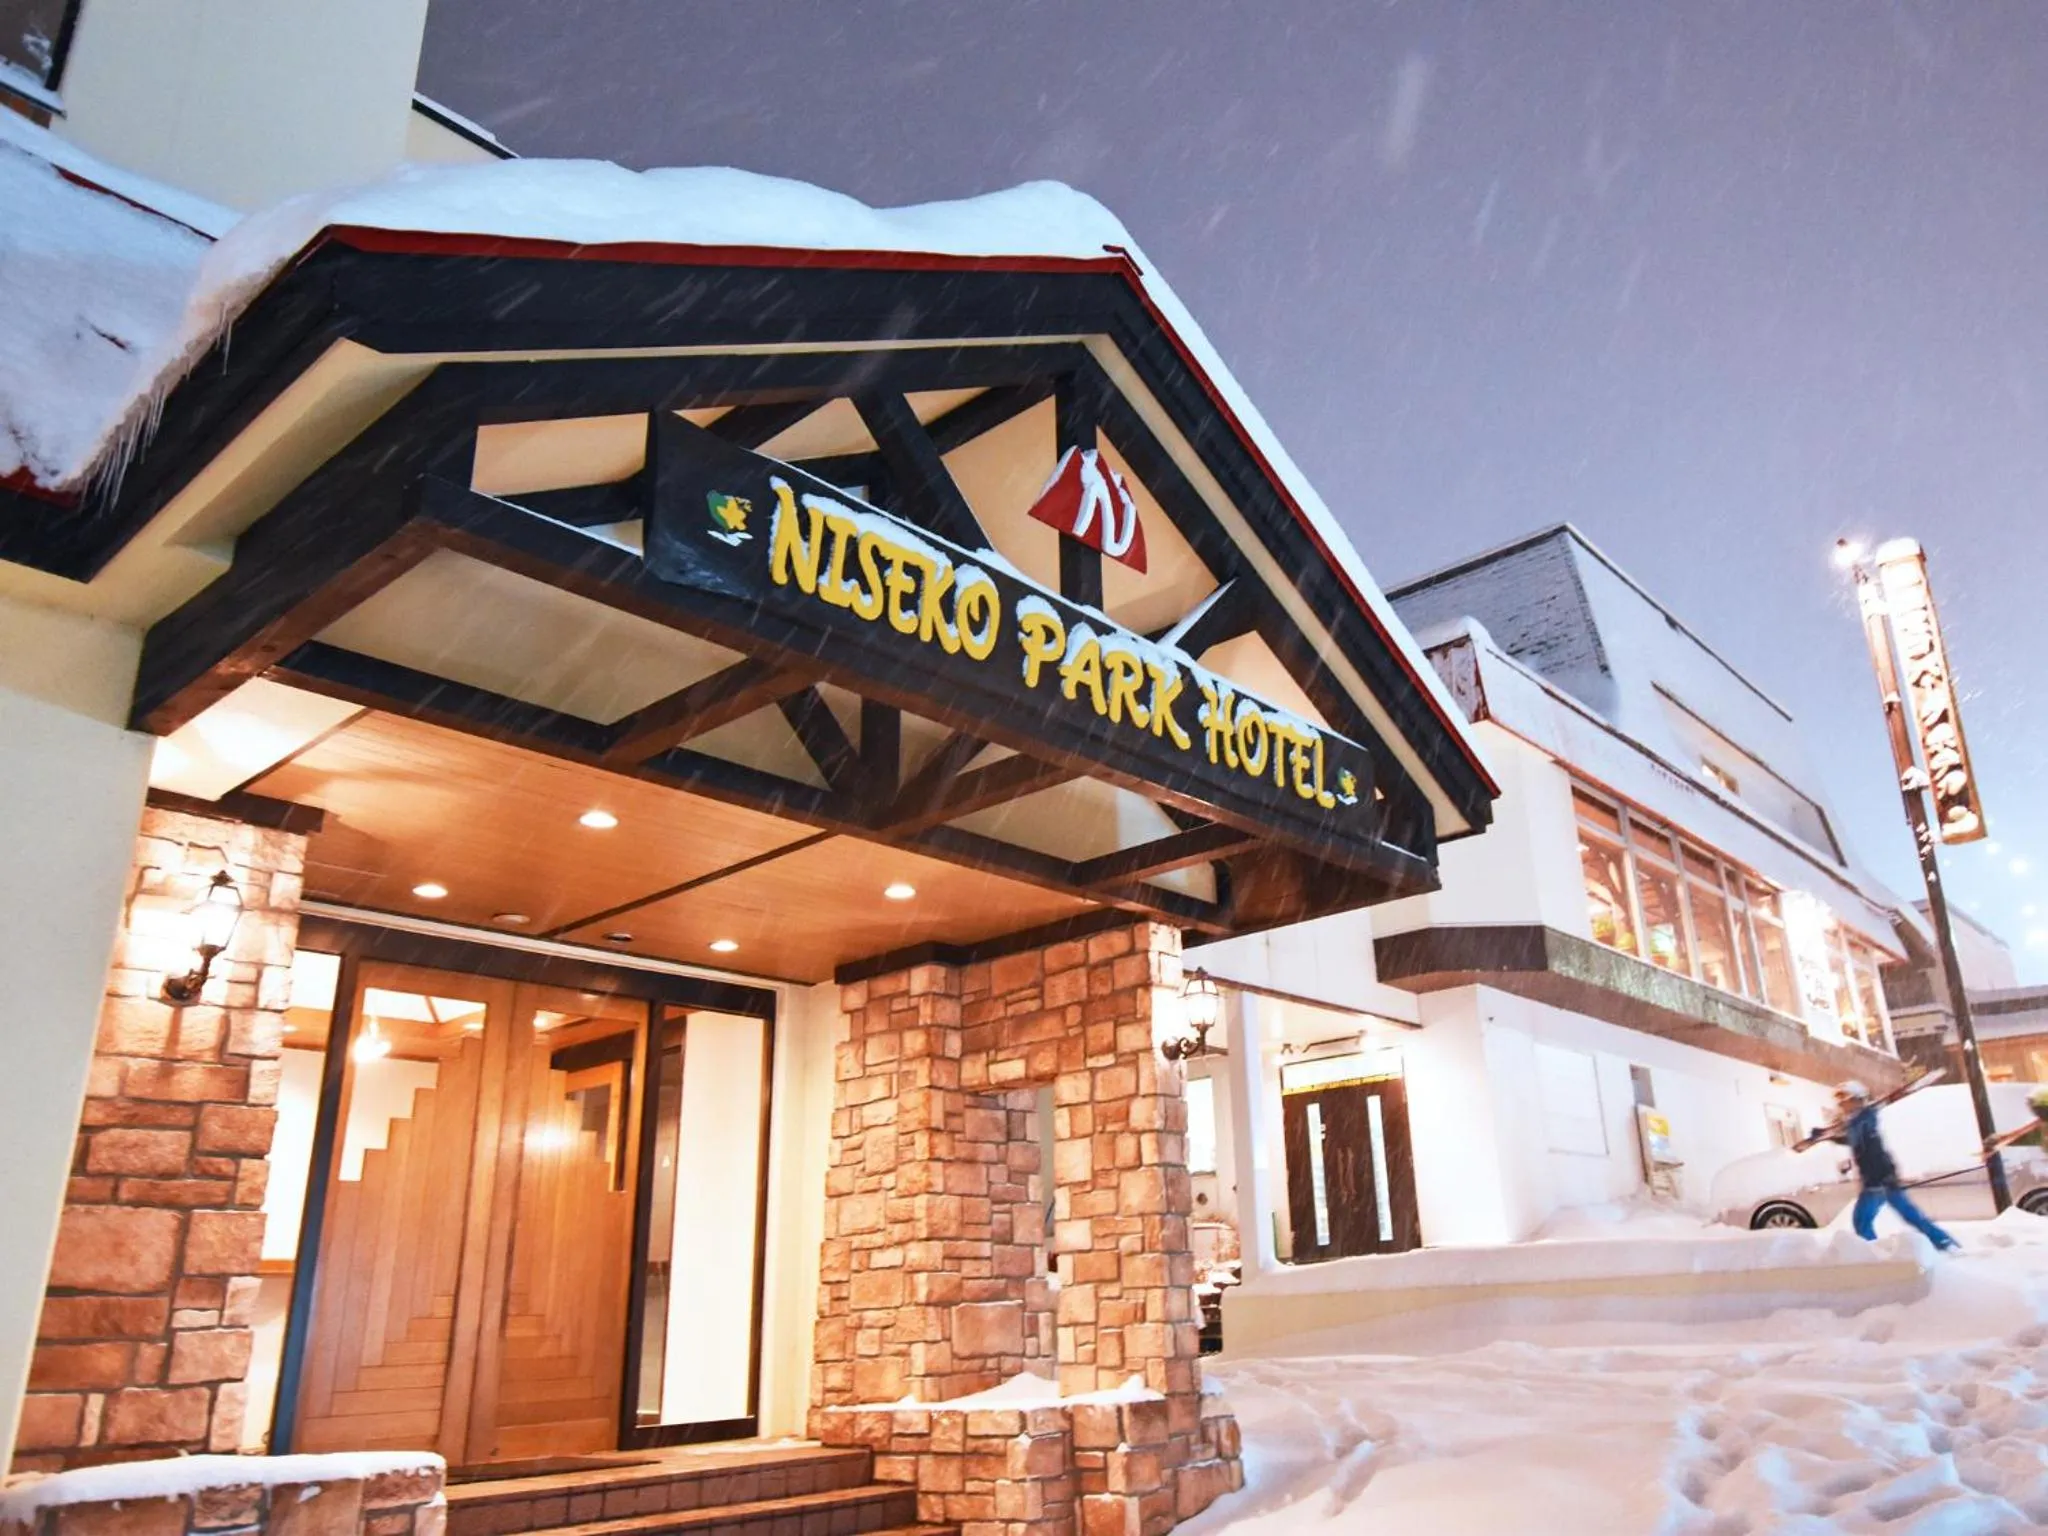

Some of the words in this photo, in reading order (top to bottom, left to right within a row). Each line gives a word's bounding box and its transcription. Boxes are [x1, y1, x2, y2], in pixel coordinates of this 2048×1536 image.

[769, 477, 1001, 661] NISEKO
[1017, 605, 1192, 751] PARK
[1199, 684, 1337, 810] HOTEL
